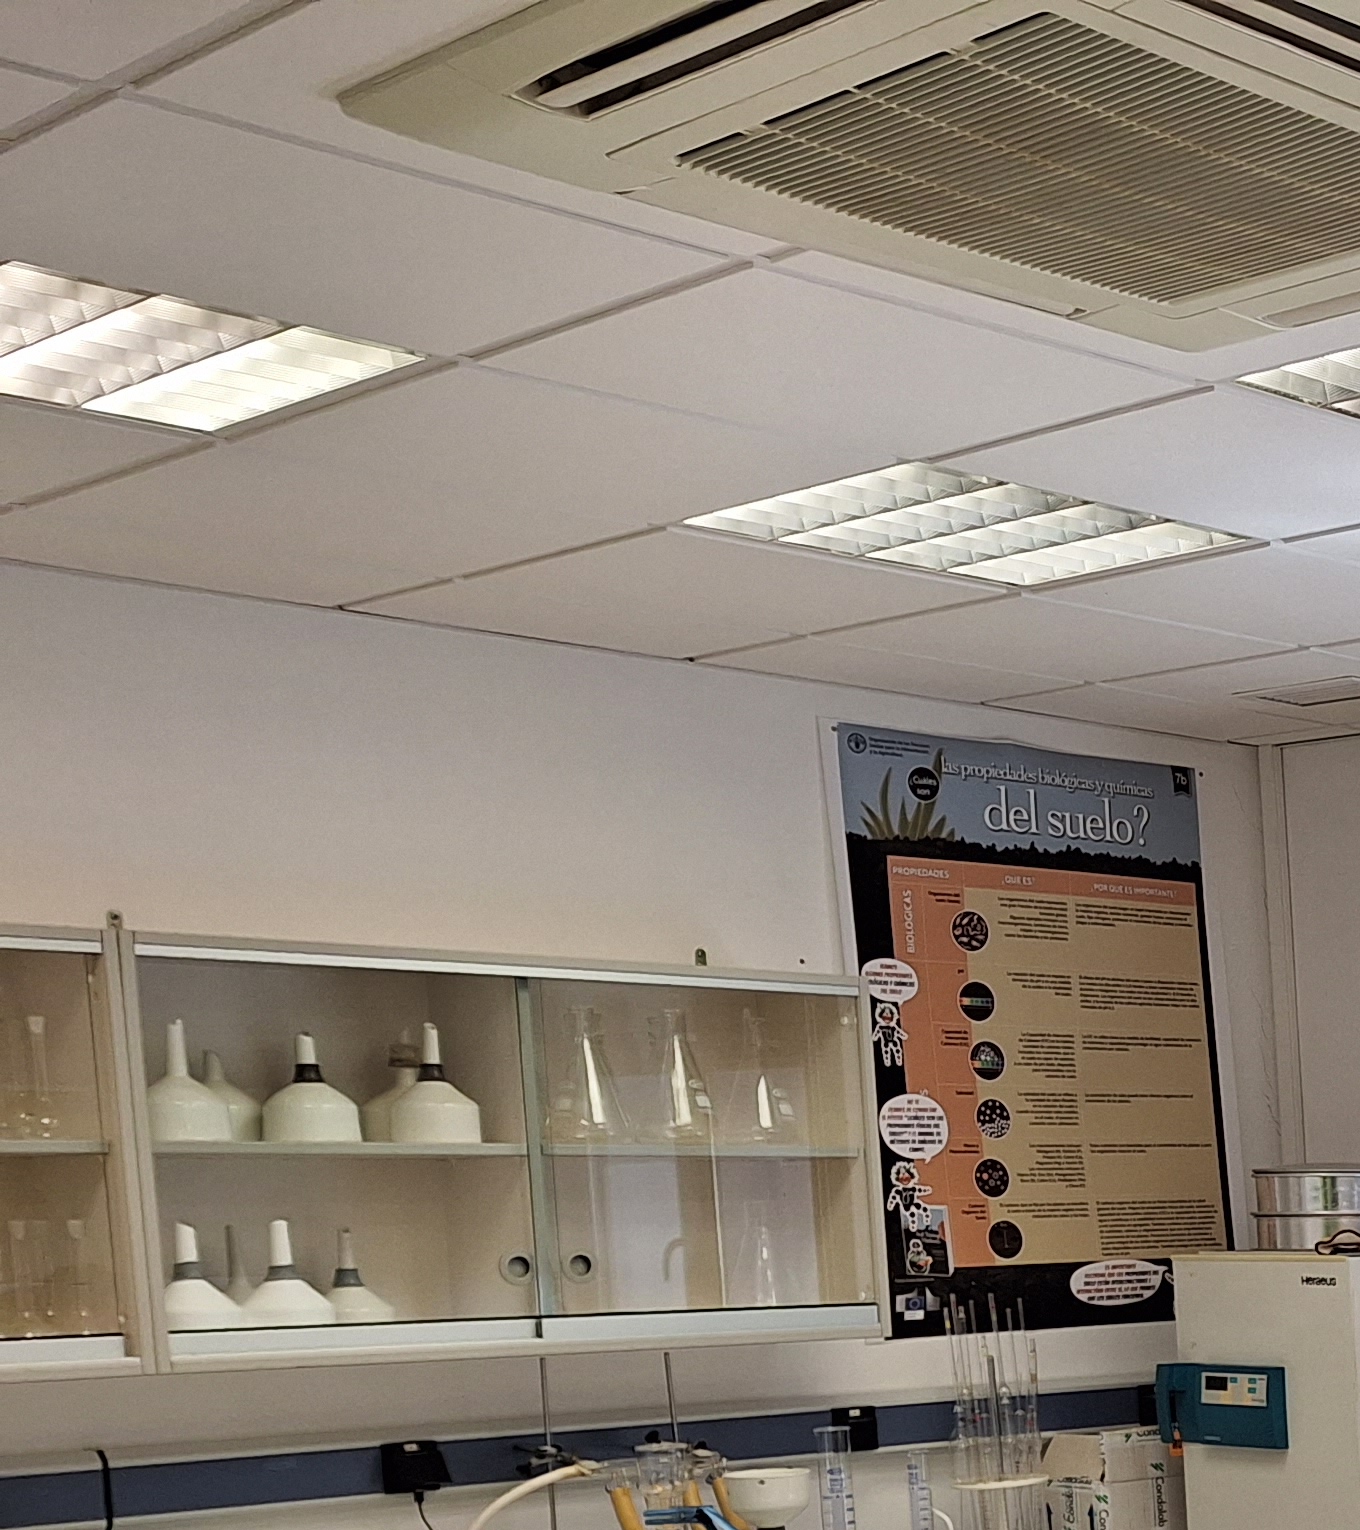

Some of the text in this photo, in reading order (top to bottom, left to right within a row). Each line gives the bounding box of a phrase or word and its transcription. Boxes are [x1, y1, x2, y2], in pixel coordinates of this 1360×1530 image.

[941, 756, 958, 774] las
[962, 762, 1037, 783] propiedades
[1039, 768, 1094, 793] biológicas
[984, 786, 1150, 846] del suelo?
[1155, 1477, 1169, 1527] Condalab
